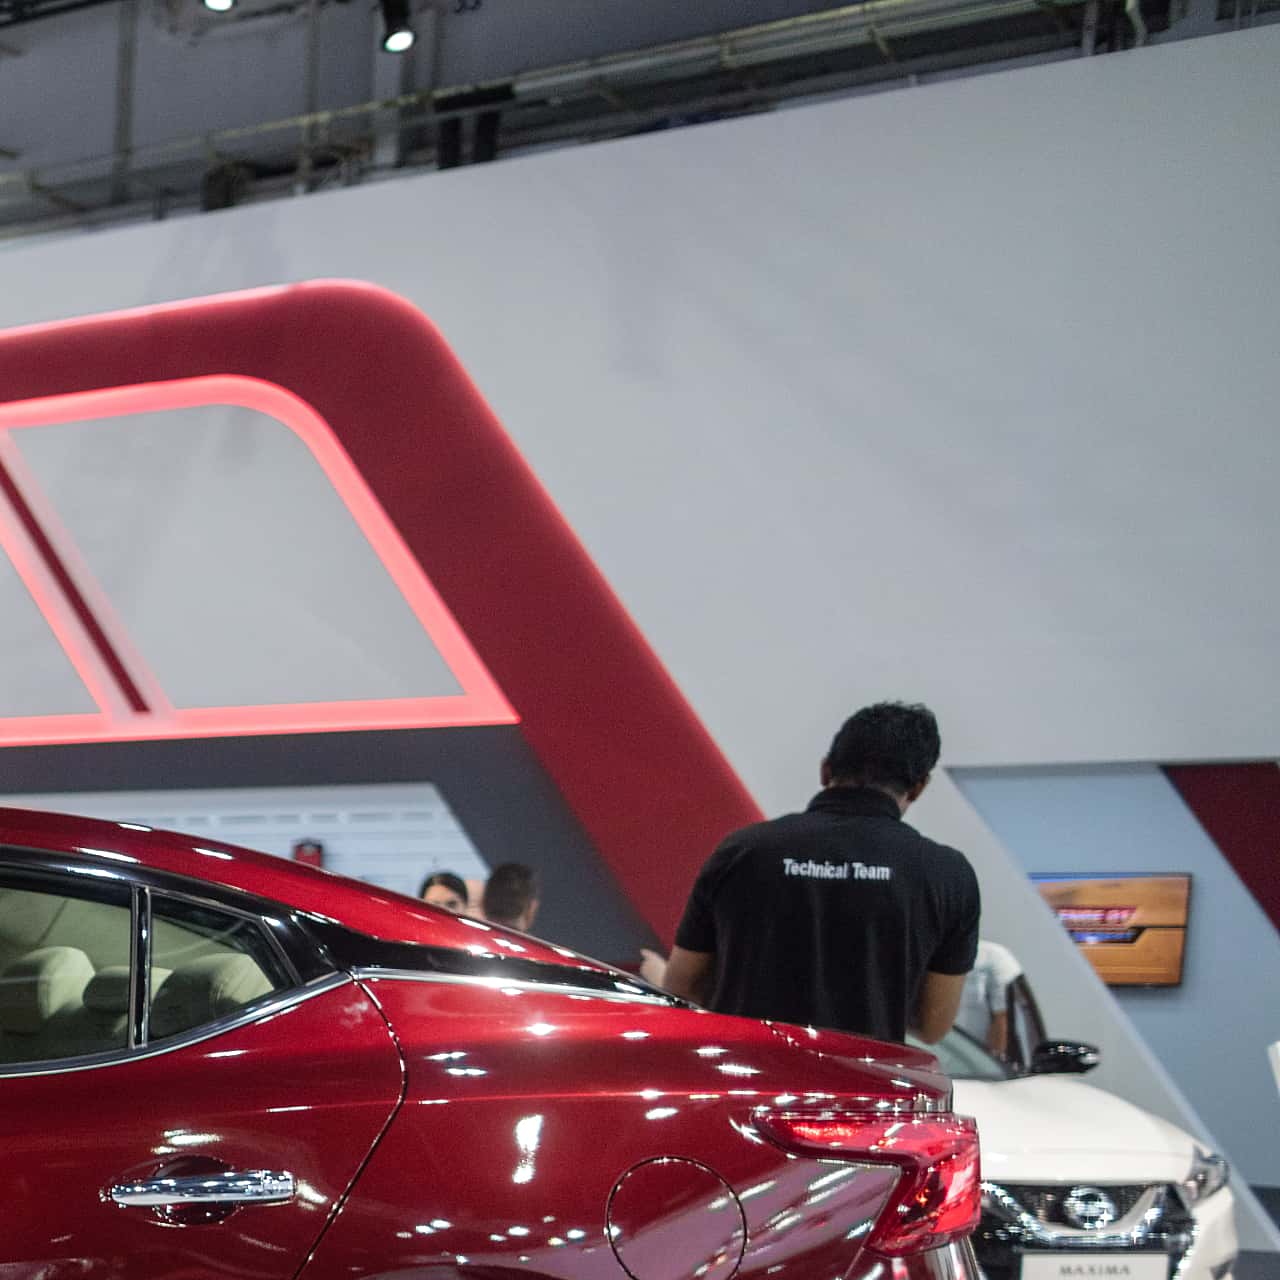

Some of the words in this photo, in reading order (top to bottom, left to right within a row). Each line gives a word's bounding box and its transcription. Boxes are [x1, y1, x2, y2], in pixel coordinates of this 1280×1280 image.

[783, 858, 849, 879] Technical
[852, 862, 891, 881] Team
[1059, 1263, 1131, 1276] MAXIMA
